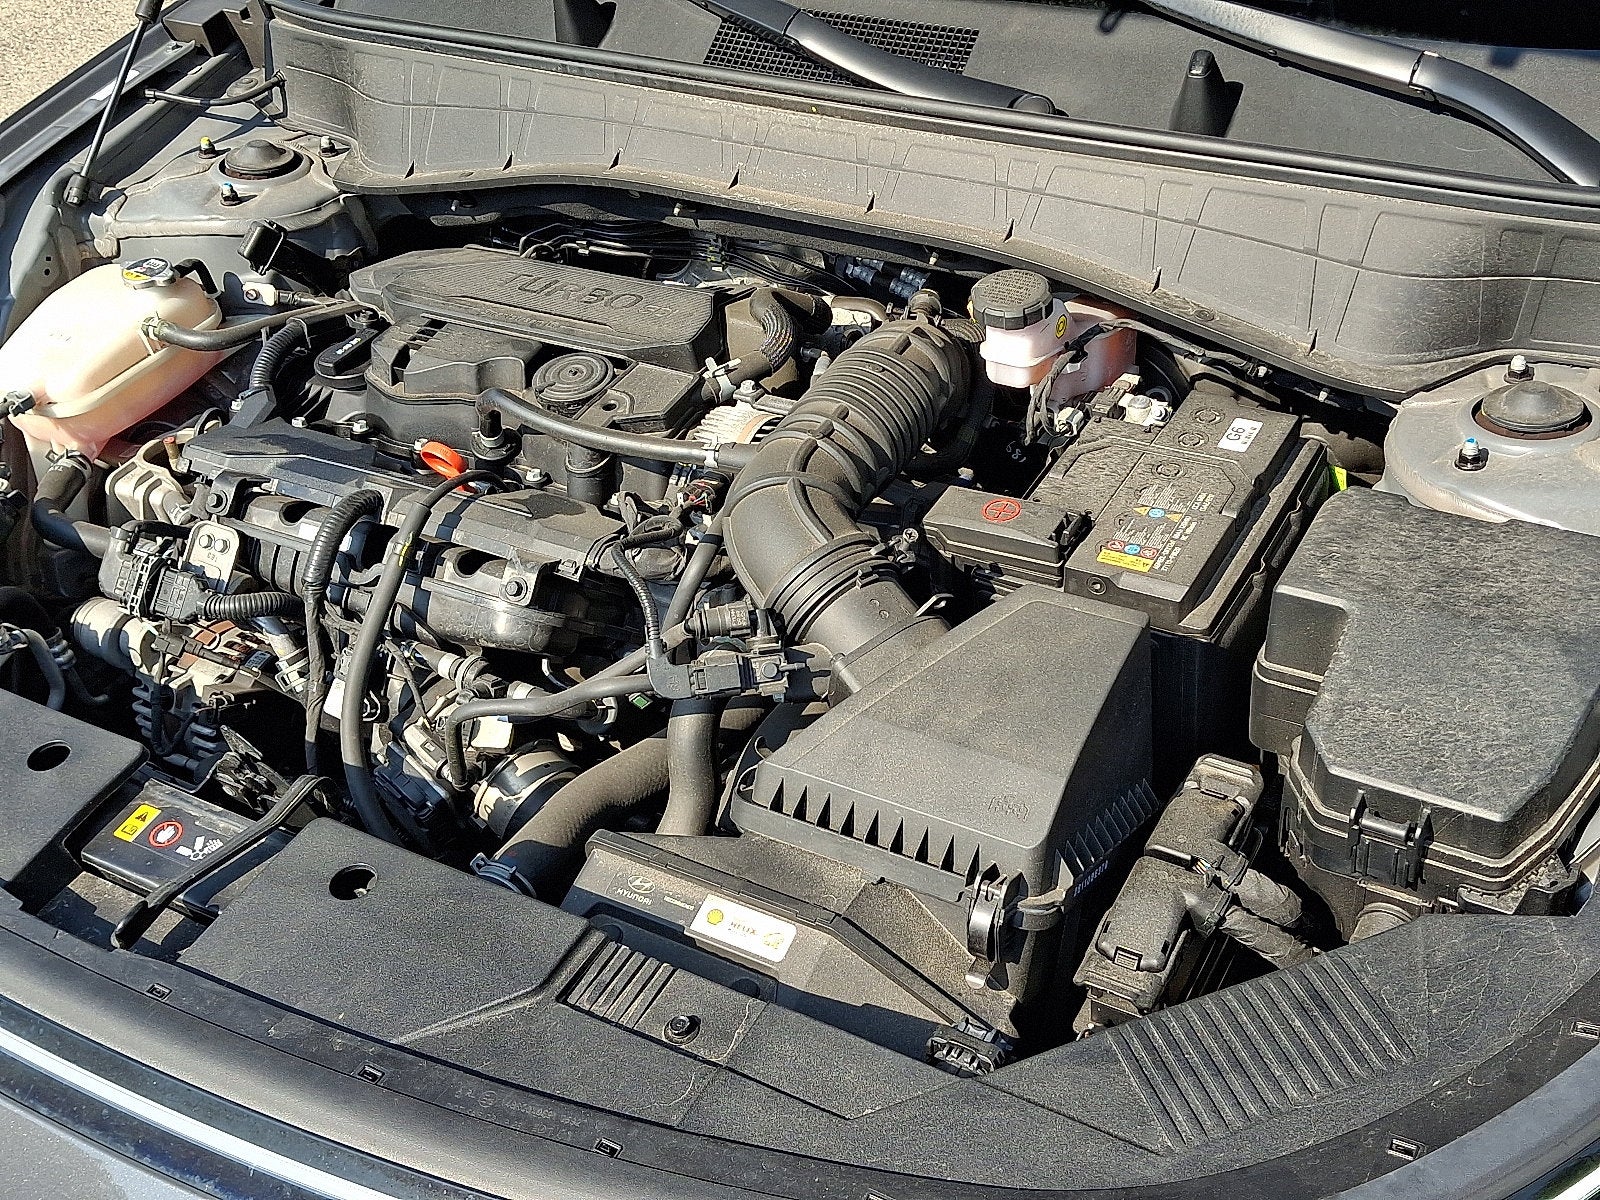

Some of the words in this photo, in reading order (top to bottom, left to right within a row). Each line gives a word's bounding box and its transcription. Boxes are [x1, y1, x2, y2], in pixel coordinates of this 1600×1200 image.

[501, 270, 644, 309] TURBO
[1226, 426, 1246, 441] G6
[616, 887, 653, 906] HYUNDAI
